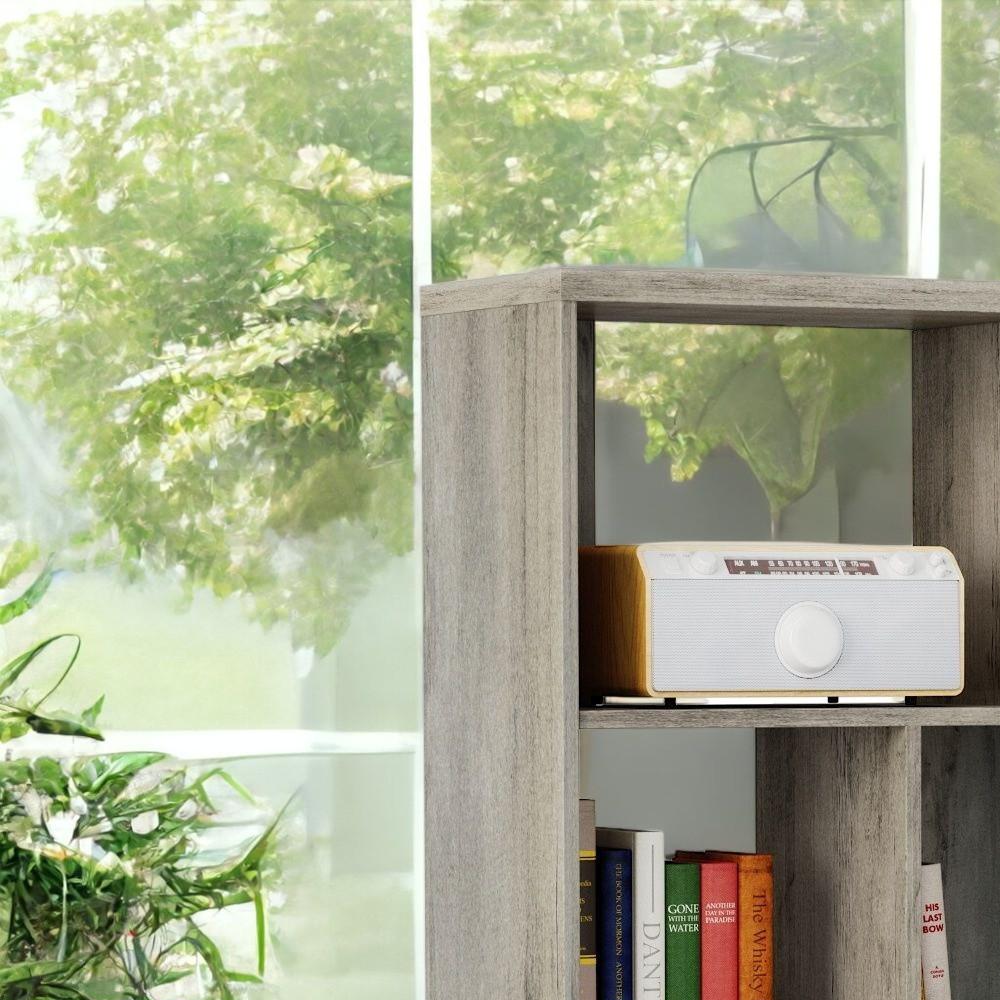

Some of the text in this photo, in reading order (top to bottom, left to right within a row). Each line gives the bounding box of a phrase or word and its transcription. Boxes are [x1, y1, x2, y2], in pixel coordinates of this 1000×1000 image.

[615, 880, 623, 903] BOOK
[668, 903, 699, 914] GONE
[753, 888, 767, 923] The
[925, 903, 939, 911] HIS
[705, 916, 736, 924] PARADISE
[922, 913, 942, 922] LAST
[669, 923, 699, 932] WATER
[922, 924, 944, 933] BOW
[615, 917, 623, 956] MORMON
[749, 929, 767, 993] Whisky
[615, 962, 623, 1000] ANOTHER
